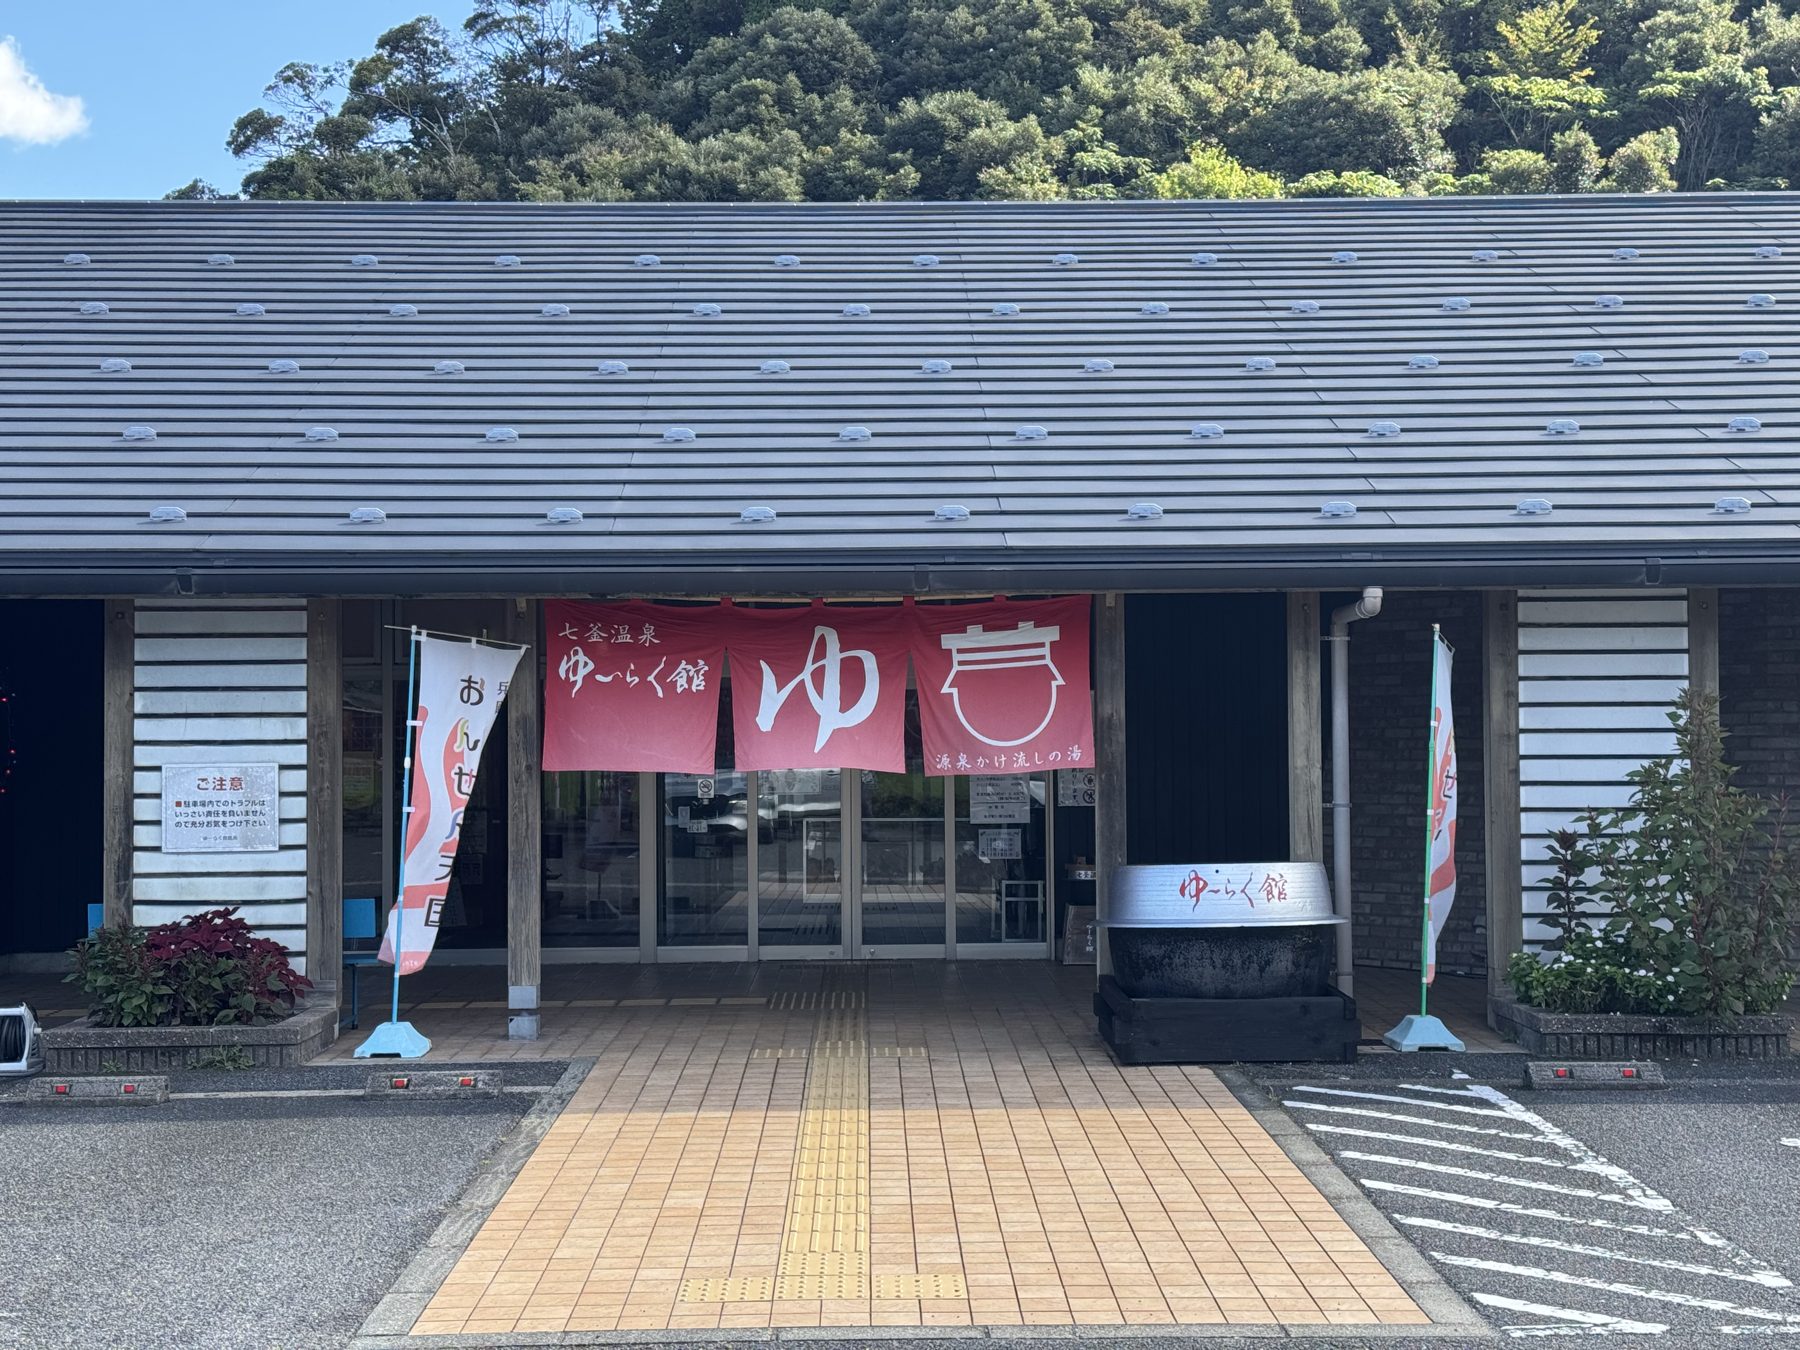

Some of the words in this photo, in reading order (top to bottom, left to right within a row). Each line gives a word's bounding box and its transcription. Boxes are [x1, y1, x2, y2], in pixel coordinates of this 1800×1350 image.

[558, 622, 661, 647] 七釜温泉
[755, 625, 880, 754] ゆ
[935, 744, 1082, 771] 源泉かけ流しの湯
[196, 776, 245, 791] ご注意
